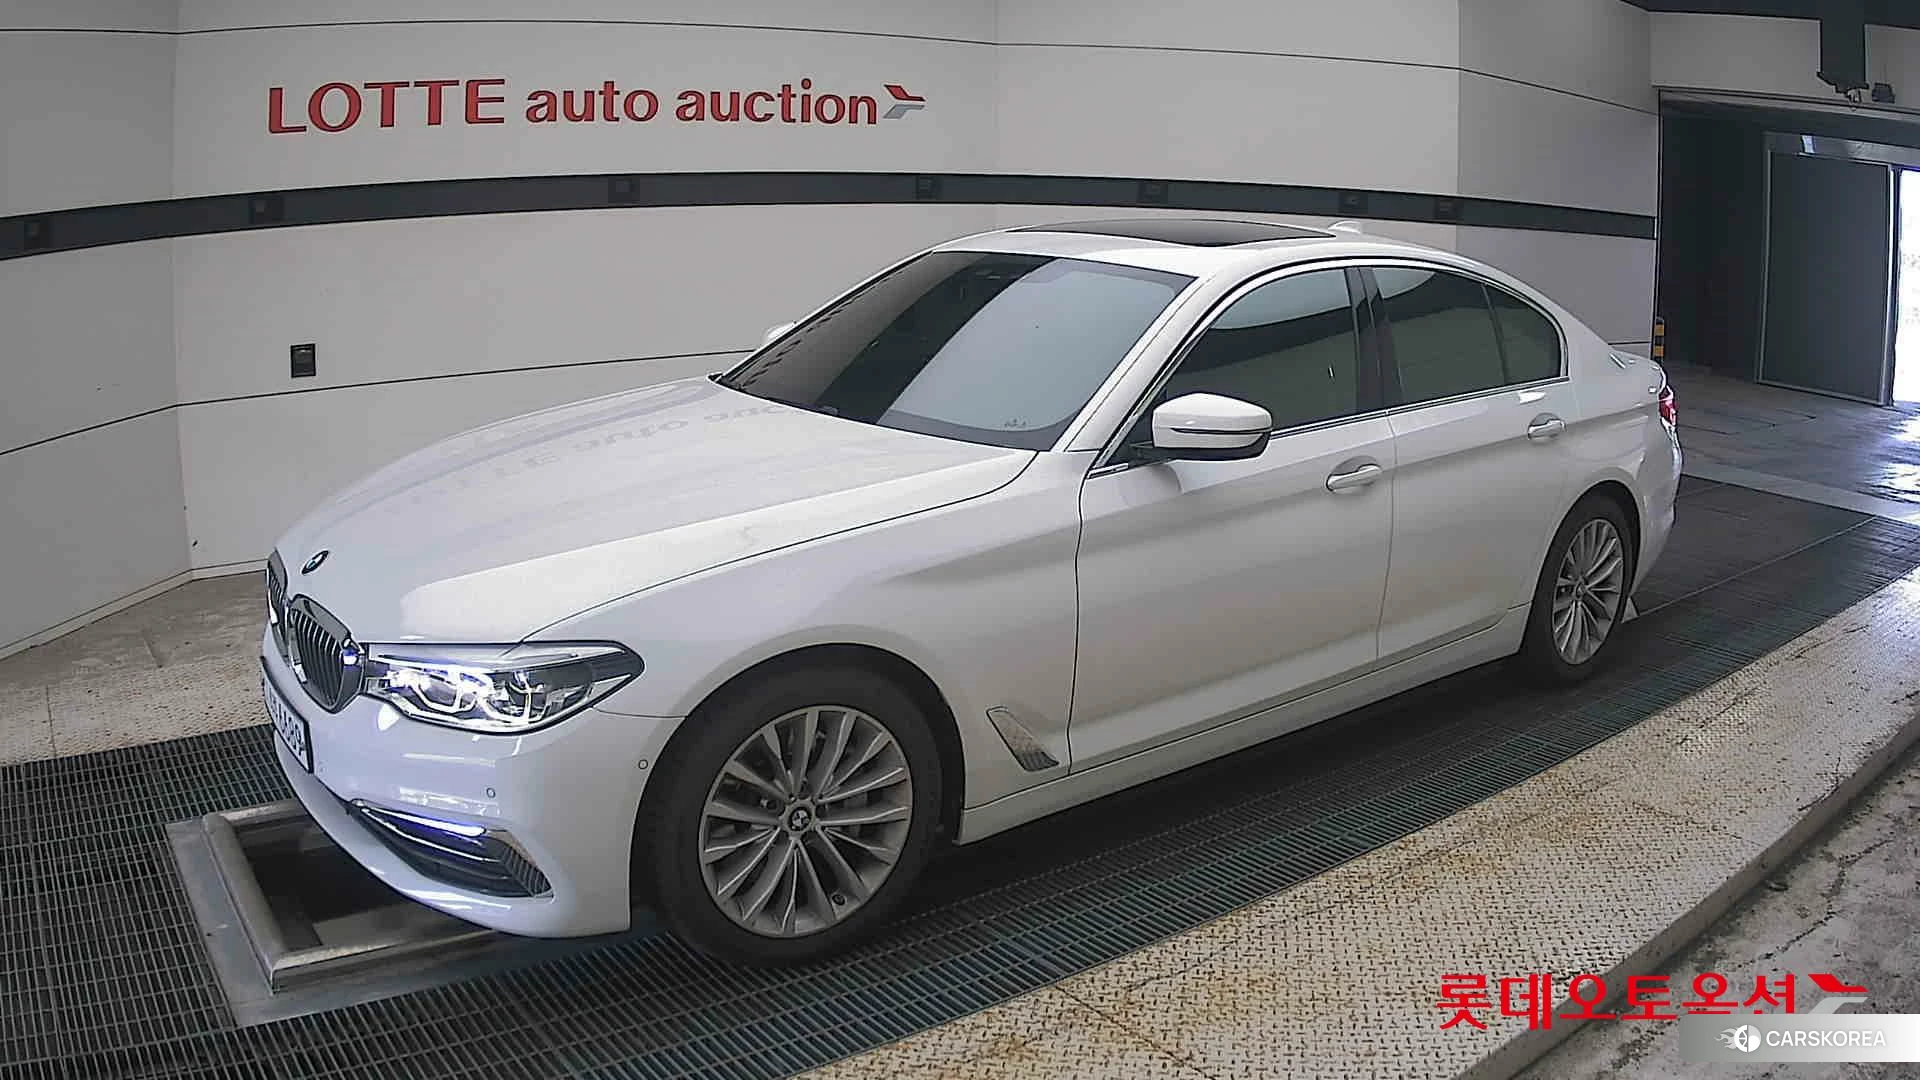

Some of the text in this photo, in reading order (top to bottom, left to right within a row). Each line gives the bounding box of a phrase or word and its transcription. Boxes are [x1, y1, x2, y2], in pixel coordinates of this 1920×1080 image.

[267, 79, 879, 134] LOTTE auto auction
